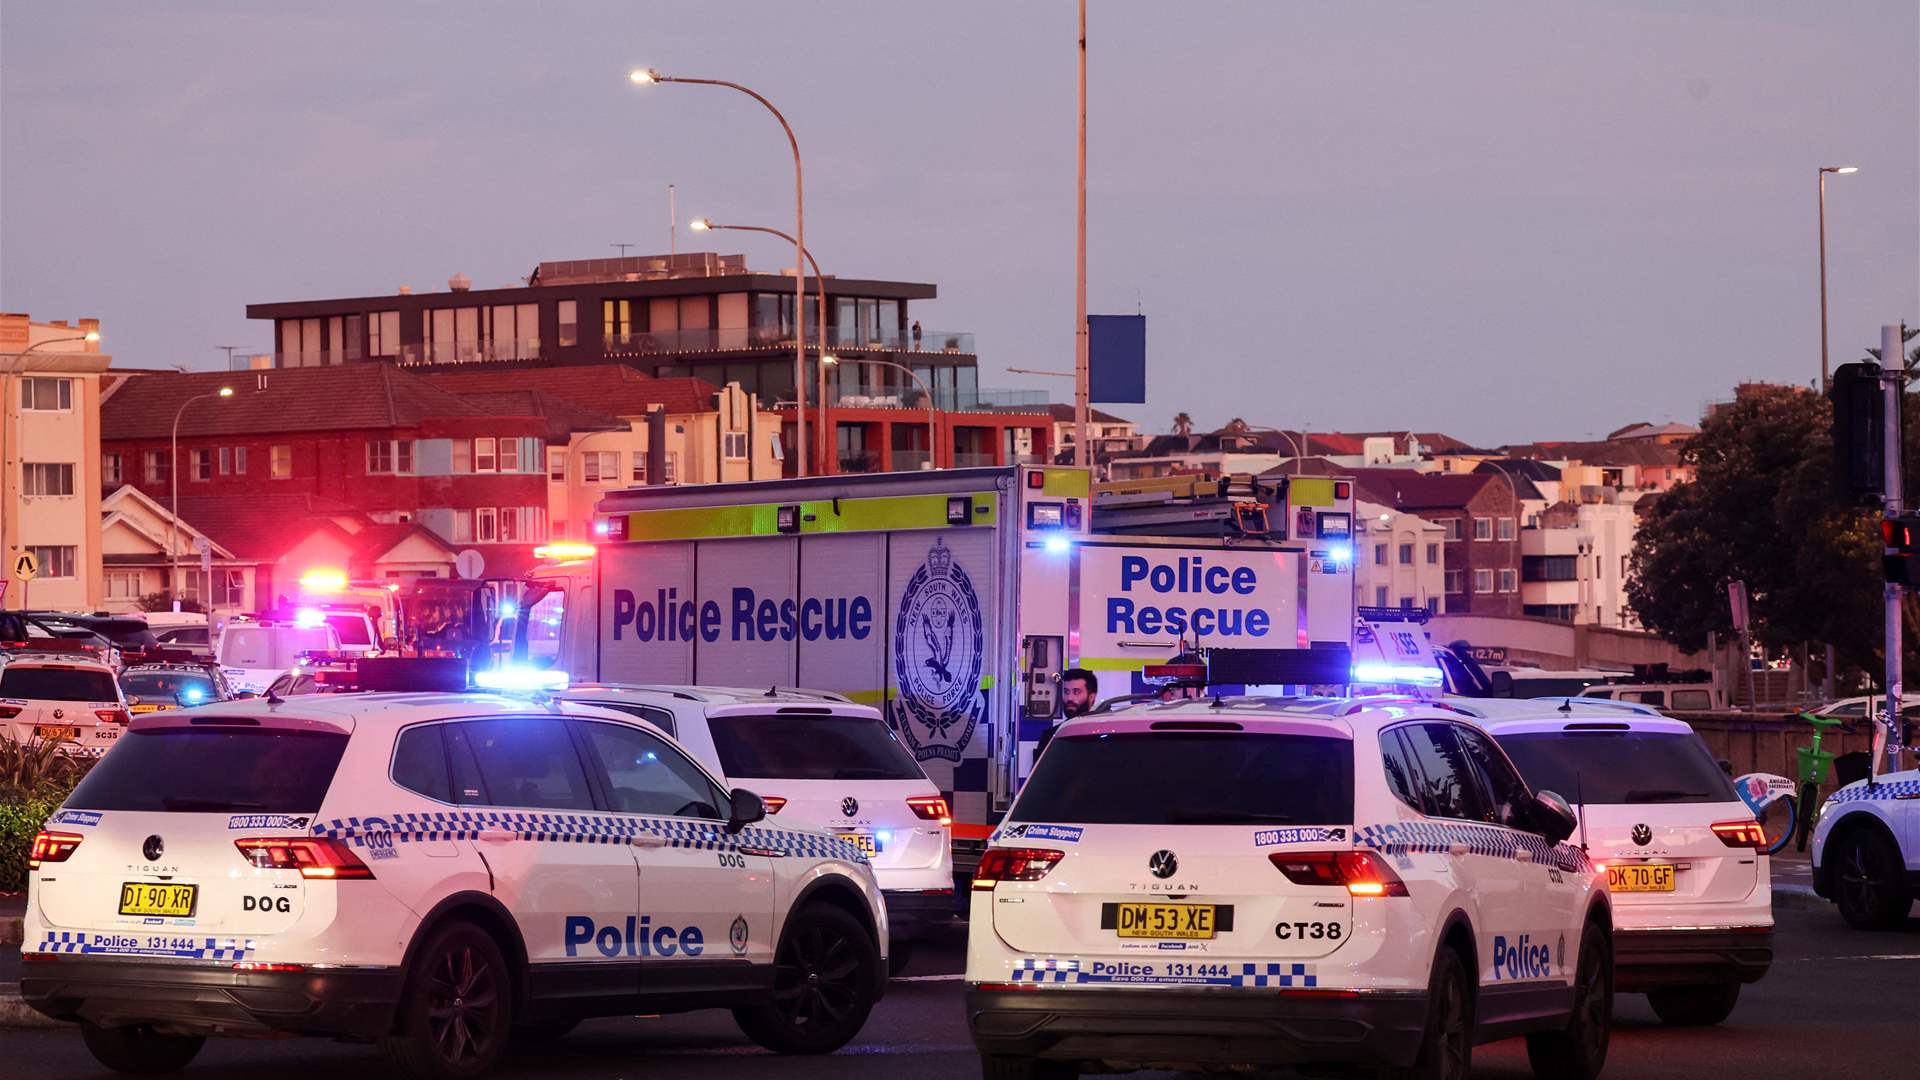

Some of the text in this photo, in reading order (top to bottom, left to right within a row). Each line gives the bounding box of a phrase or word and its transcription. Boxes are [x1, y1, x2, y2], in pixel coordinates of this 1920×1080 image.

[1122, 556, 1256, 594] Police
[910, 582, 968, 626] NEW SOUTH WALES
[614, 587, 872, 642] Police Rescue
[1107, 598, 1270, 636] Rescue
[1476, 650, 1504, 660] (2.7m)
[914, 676, 962, 704] POLICE FORCE
[230, 816, 282, 828] 1800 333 000
[366, 830, 392, 850] 000
[1028, 826, 1080, 839] Crime Stoppers
[1256, 829, 1318, 845] 1800 333 000
[718, 854, 746, 868] DOG
[244, 896, 290, 912] DOG
[565, 916, 704, 957] Police
[1276, 922, 1342, 940] CT38
[94, 935, 194, 949] Police 131 444
[1494, 934, 1550, 980] Police
[1092, 962, 1228, 976] Police 131 444
